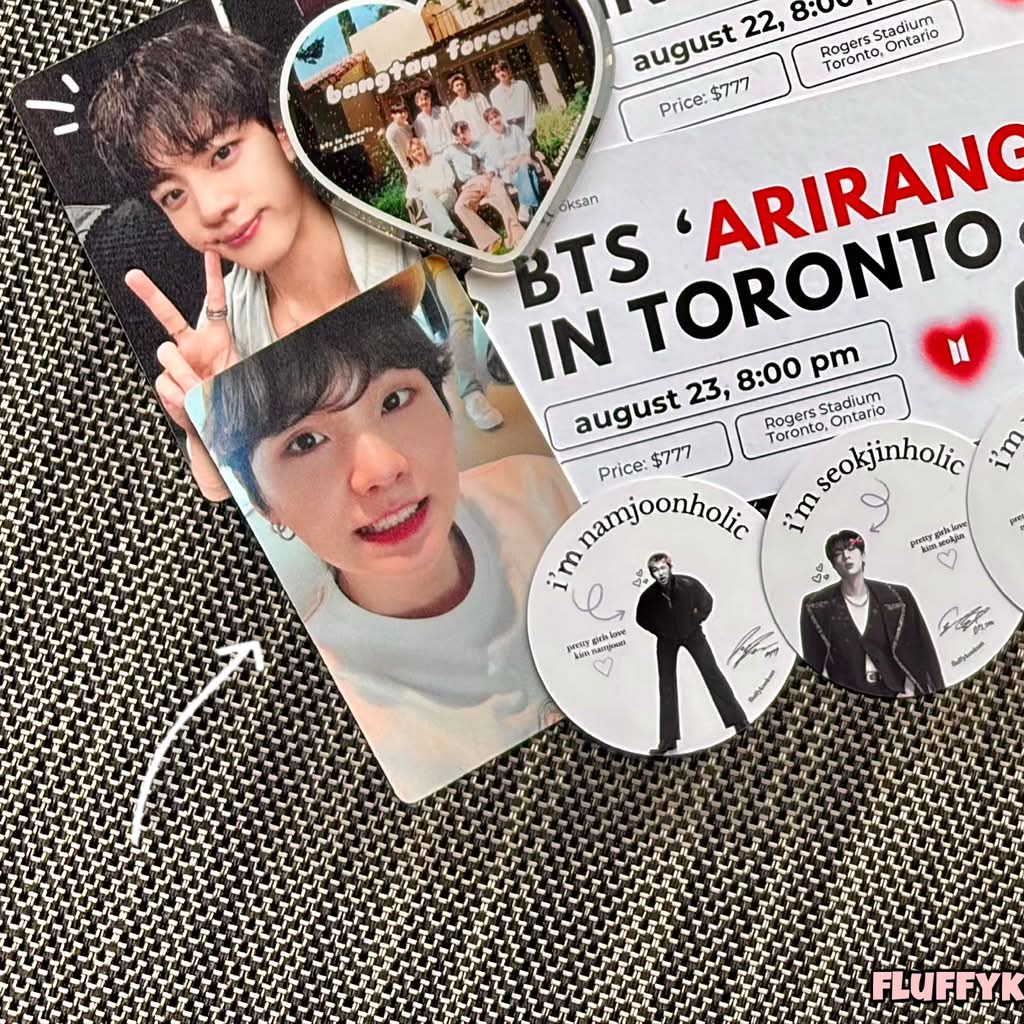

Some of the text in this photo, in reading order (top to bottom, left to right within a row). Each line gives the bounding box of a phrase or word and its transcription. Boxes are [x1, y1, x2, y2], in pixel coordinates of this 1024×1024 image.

[326, 13, 542, 106] bangtan forever
[632, 22, 738, 72] august
[740, 9, 786, 39] 22,
[820, 12, 935, 61] Rogers Stadium
[821, 26, 940, 74] Toronto, Ontario
[659, 76, 751, 118] Price: $777
[514, 224, 650, 310] BTS
[528, 210, 1003, 382] IN TORONTO
[574, 344, 861, 435] august 23, 8:00 pm
[764, 390, 882, 432] Rogers Stadium
[765, 404, 886, 444] Toronto, Ontario
[598, 444, 693, 482] Price: $777
[782, 437, 966, 534] i'm seokjinholic
[546, 492, 750, 592] i'm namjoonholic
[910, 520, 968, 549] pretty girls love
[921, 532, 966, 554] kim seokjin
[566, 628, 627, 654] pretty girls love
[574, 638, 626, 660] kim namjoon
